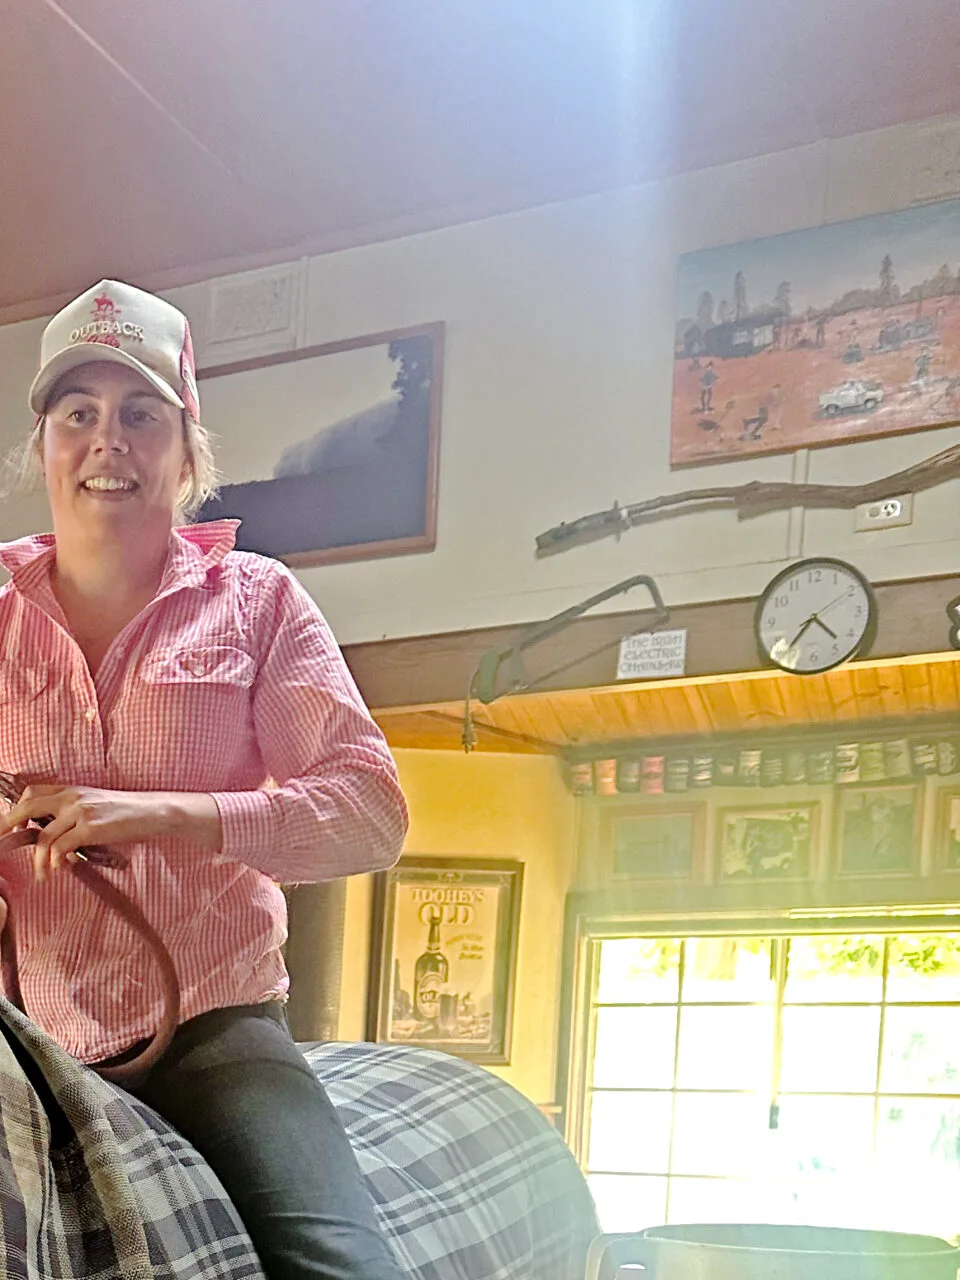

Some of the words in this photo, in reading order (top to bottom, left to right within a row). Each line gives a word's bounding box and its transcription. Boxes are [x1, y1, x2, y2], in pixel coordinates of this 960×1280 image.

[70, 320, 145, 343] OUTBACK
[808, 570, 823, 584] 12
[789, 579, 800, 592] 11
[774, 595, 789, 609] 10
[411, 888, 484, 902] TOOHEYS
[418, 901, 474, 925] OLD
